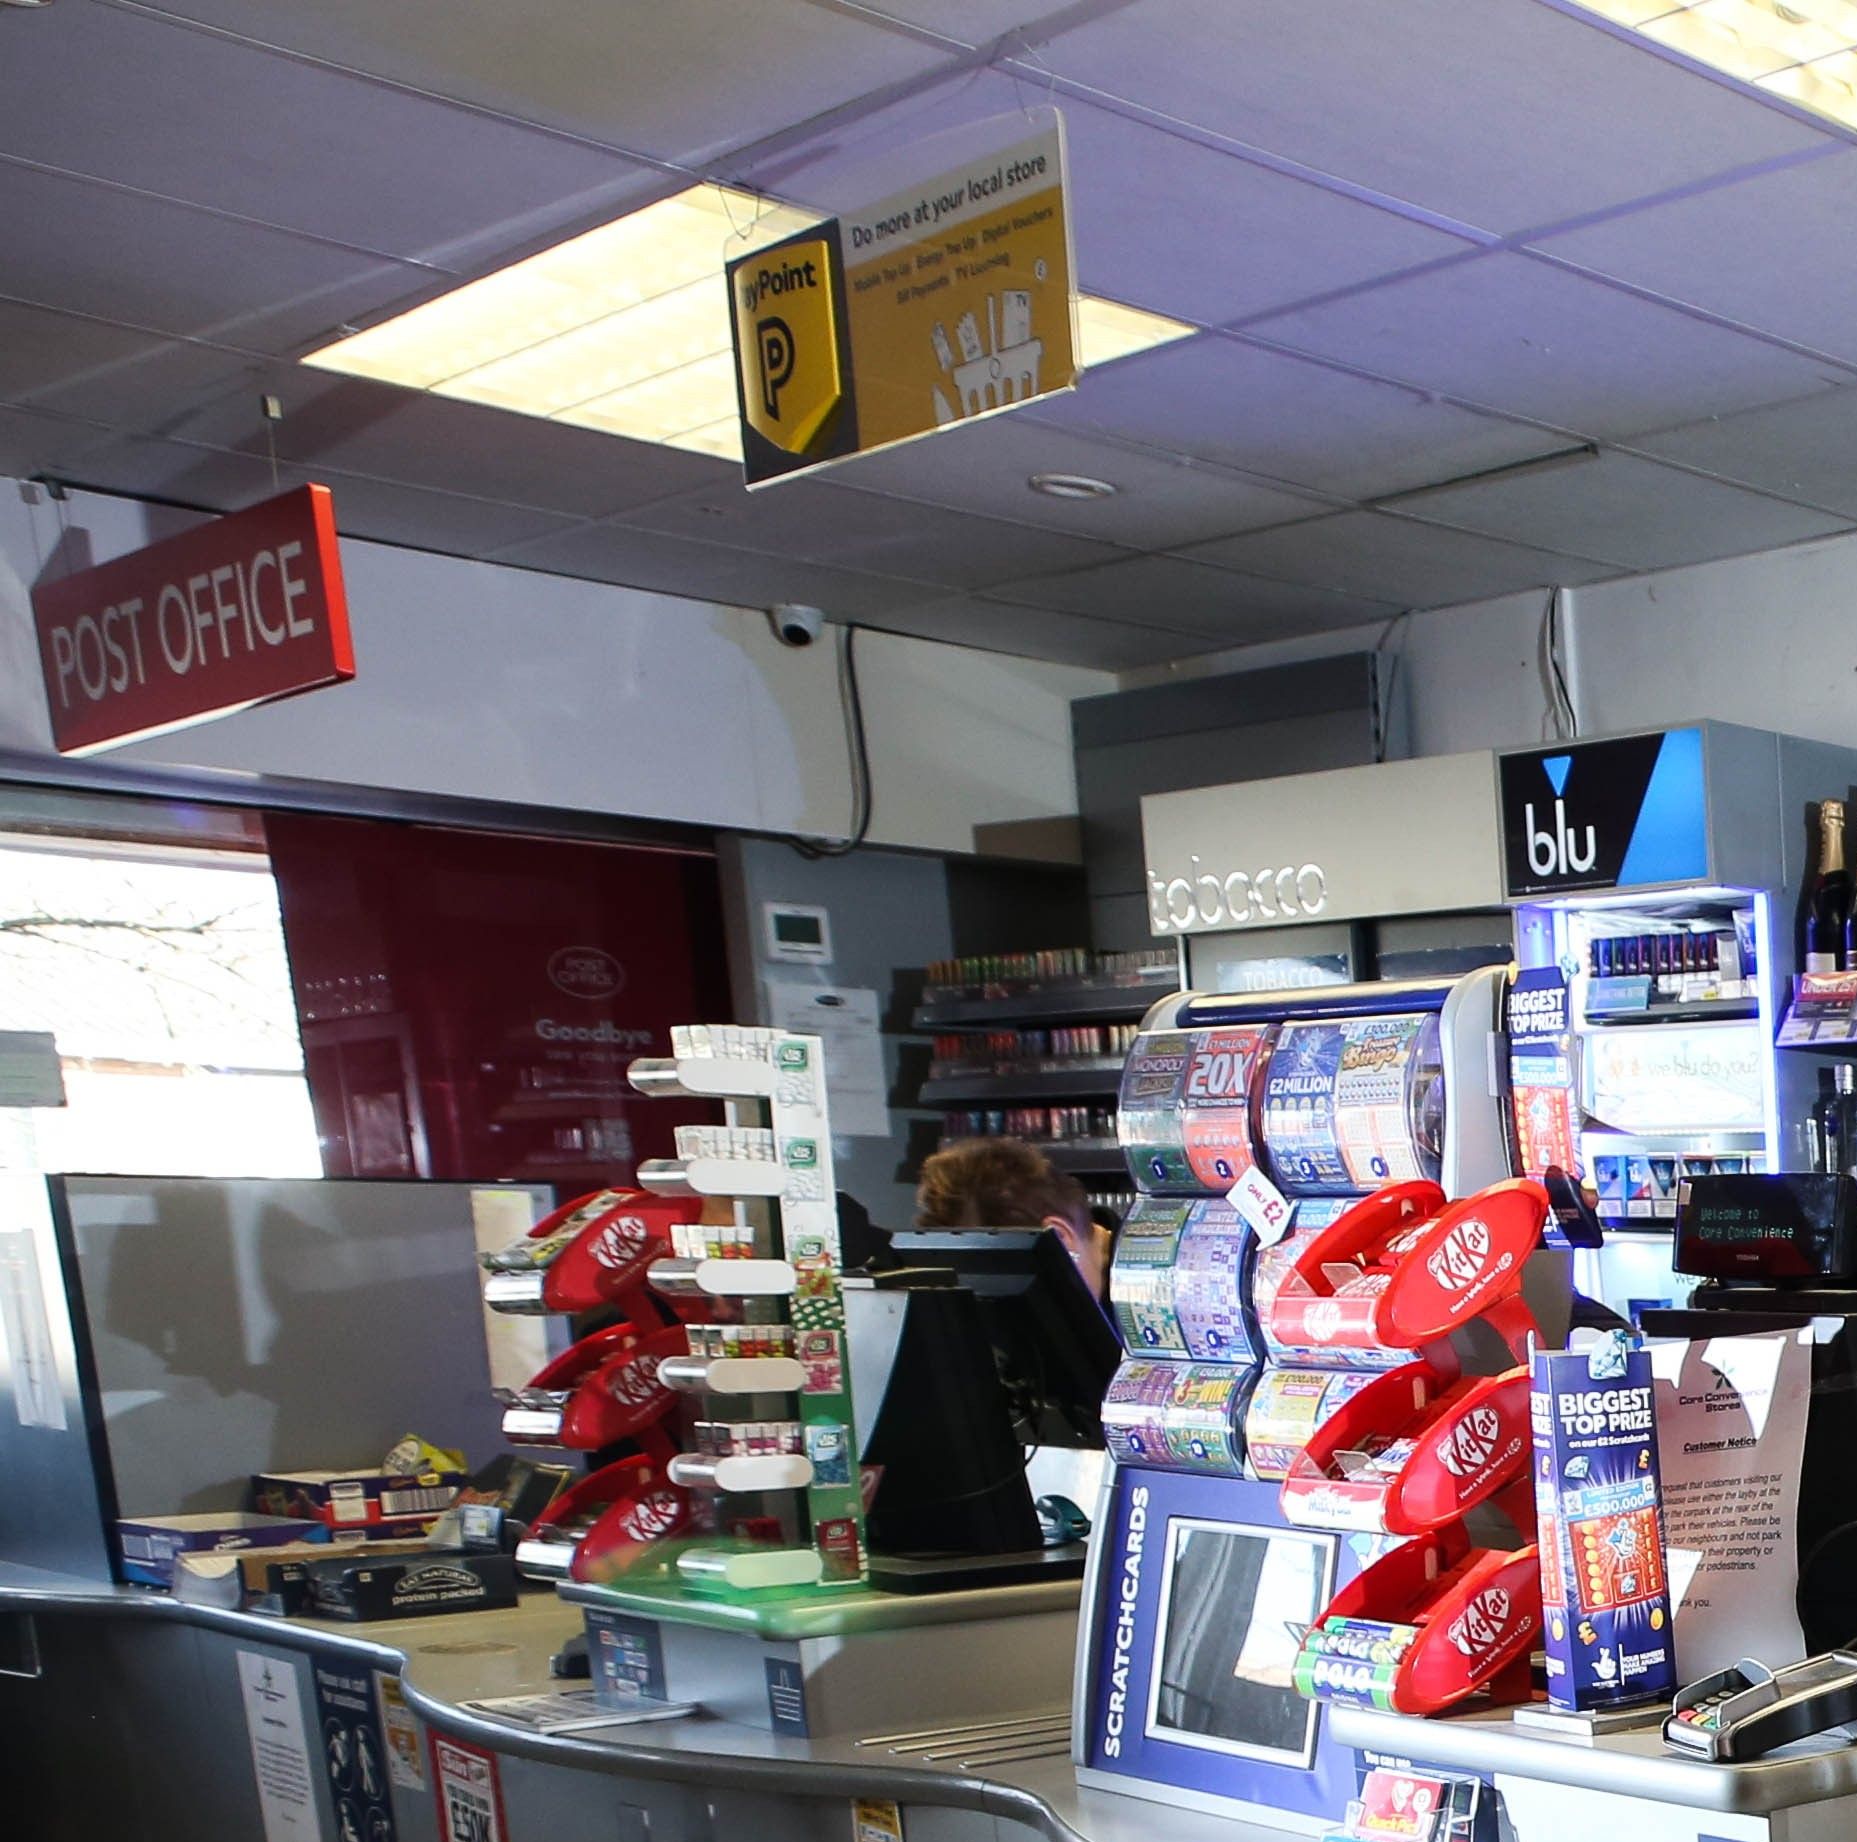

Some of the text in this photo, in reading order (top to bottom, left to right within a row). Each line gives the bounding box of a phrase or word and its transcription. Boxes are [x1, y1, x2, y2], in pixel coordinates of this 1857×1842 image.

[853, 155, 1046, 248] Do more at your local store
[52, 539, 312, 708] POST OFFICE
[1526, 798, 1594, 877] blu
[1151, 855, 1327, 931] tobacco
[1188, 1052, 1250, 1095] 20X
[1270, 1076, 1333, 1095] £2MILLION
[1263, 1201, 1284, 1227] £2
[1699, 1227, 1734, 1242] Core
[1748, 1206, 1760, 1220] to
[1559, 1388, 1651, 1416] BIGGEST
[1561, 1410, 1652, 1436] TOP PRIZE
[1437, 1404, 1500, 1479] KitKat
[1684, 1438, 1757, 1452] Customer Notice
[1104, 1487, 1149, 1759] SCRATCHCARDS
[1451, 1588, 1509, 1656] KitKat
